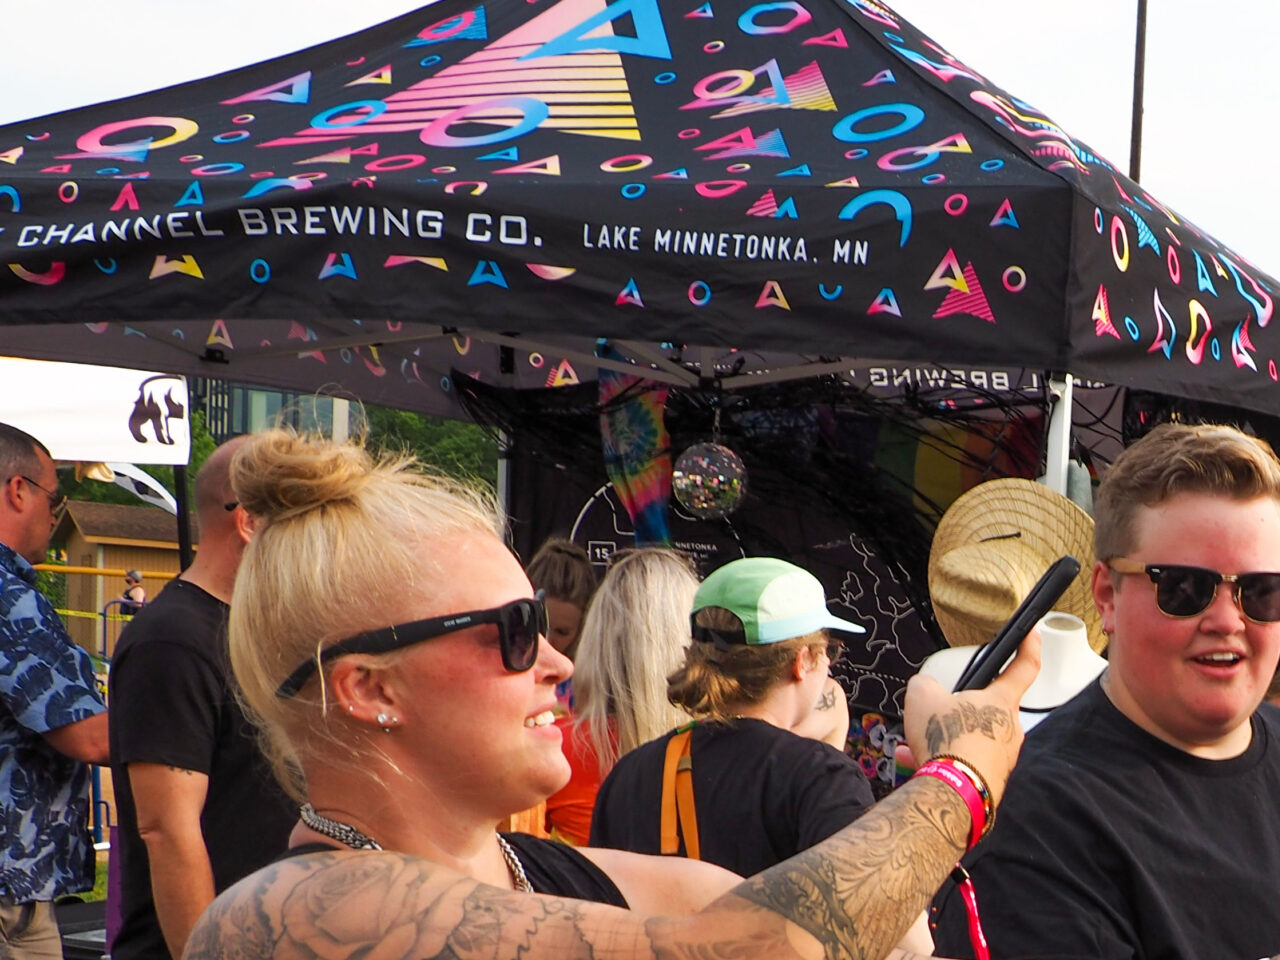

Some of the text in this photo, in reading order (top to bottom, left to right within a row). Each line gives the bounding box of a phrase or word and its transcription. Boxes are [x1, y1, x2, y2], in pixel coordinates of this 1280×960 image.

[16, 206, 543, 247] CHANNEL BREWING CO.
[583, 223, 641, 251] LAKE
[832, 239, 869, 266] MN
[675, 541, 718, 552] NNETONKA
